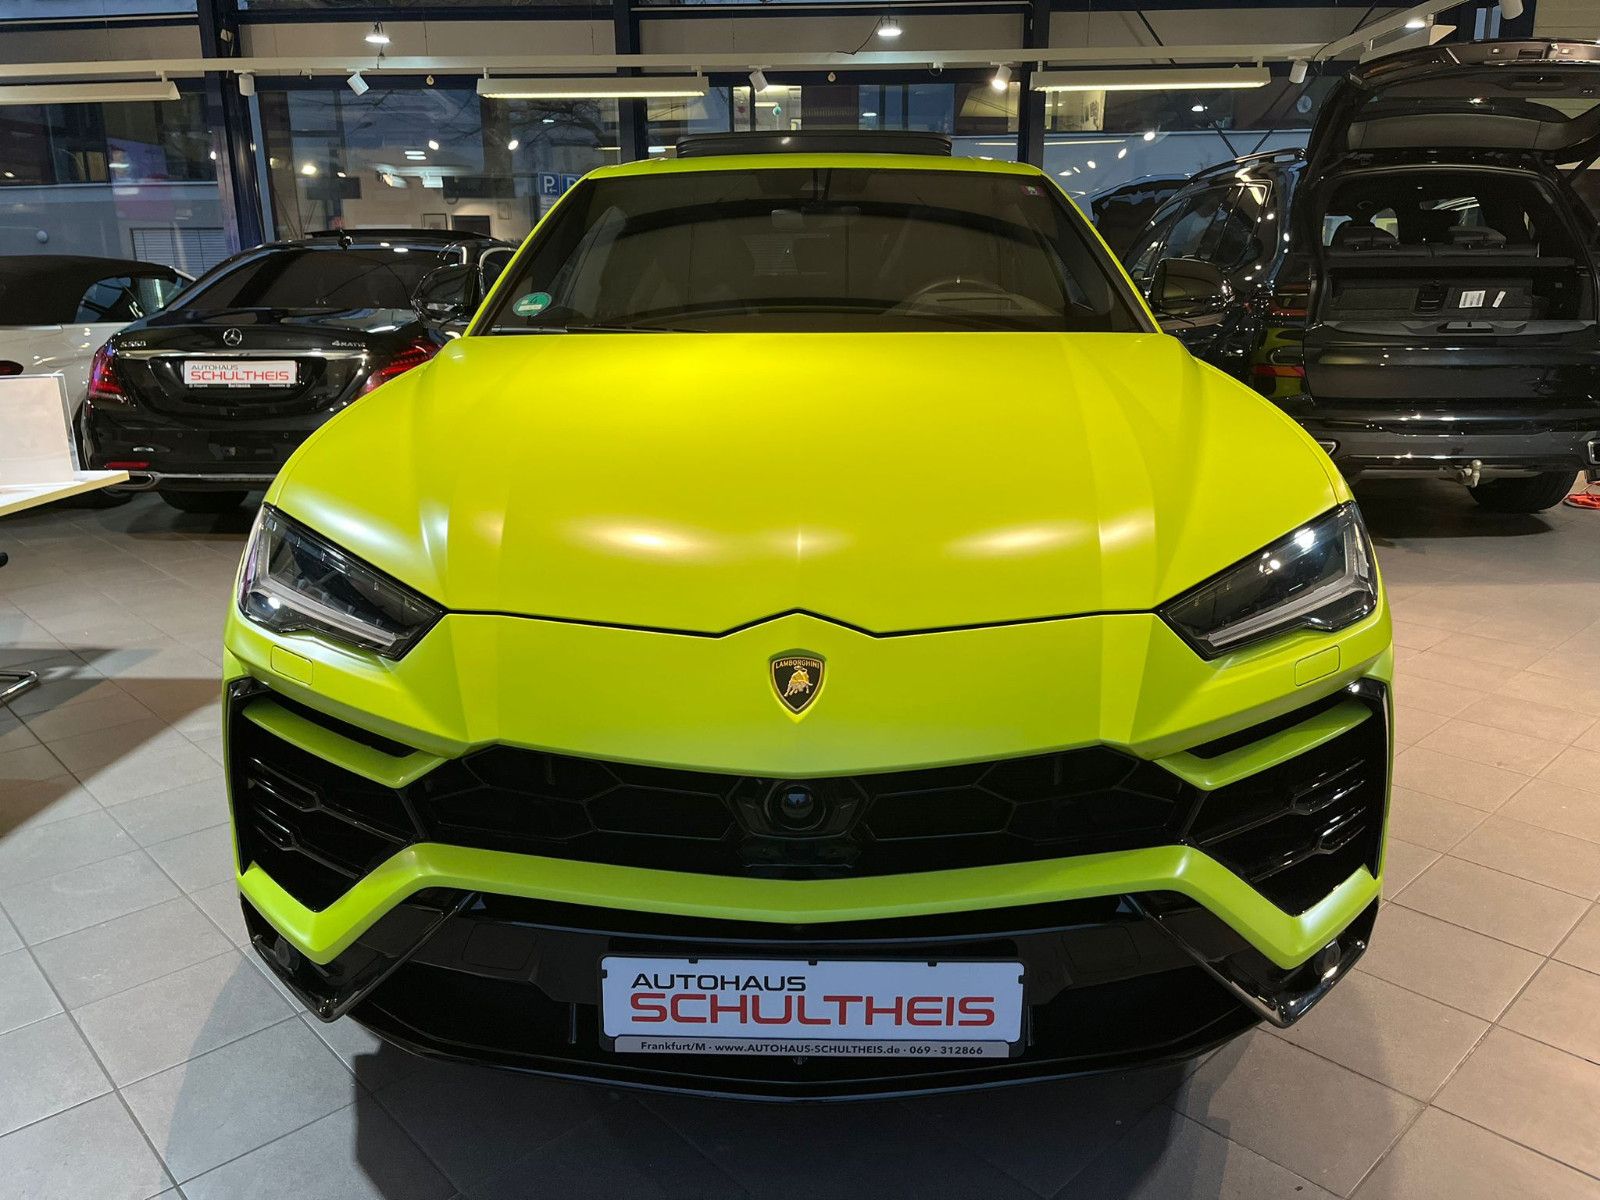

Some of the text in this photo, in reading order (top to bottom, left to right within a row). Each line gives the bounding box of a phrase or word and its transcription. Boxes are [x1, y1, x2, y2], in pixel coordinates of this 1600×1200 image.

[544, 175, 555, 193] P
[190, 370, 290, 381] SCHULTHEIS
[775, 659, 820, 669] LAMBORGHINI
[631, 973, 807, 992] AUTOHAUS
[630, 992, 995, 1026] SCHULTHEIS
[640, 1041, 984, 1056] Frankfurt/M www.AUTOHAUS-SCHULTHEIS.de 069 312866
